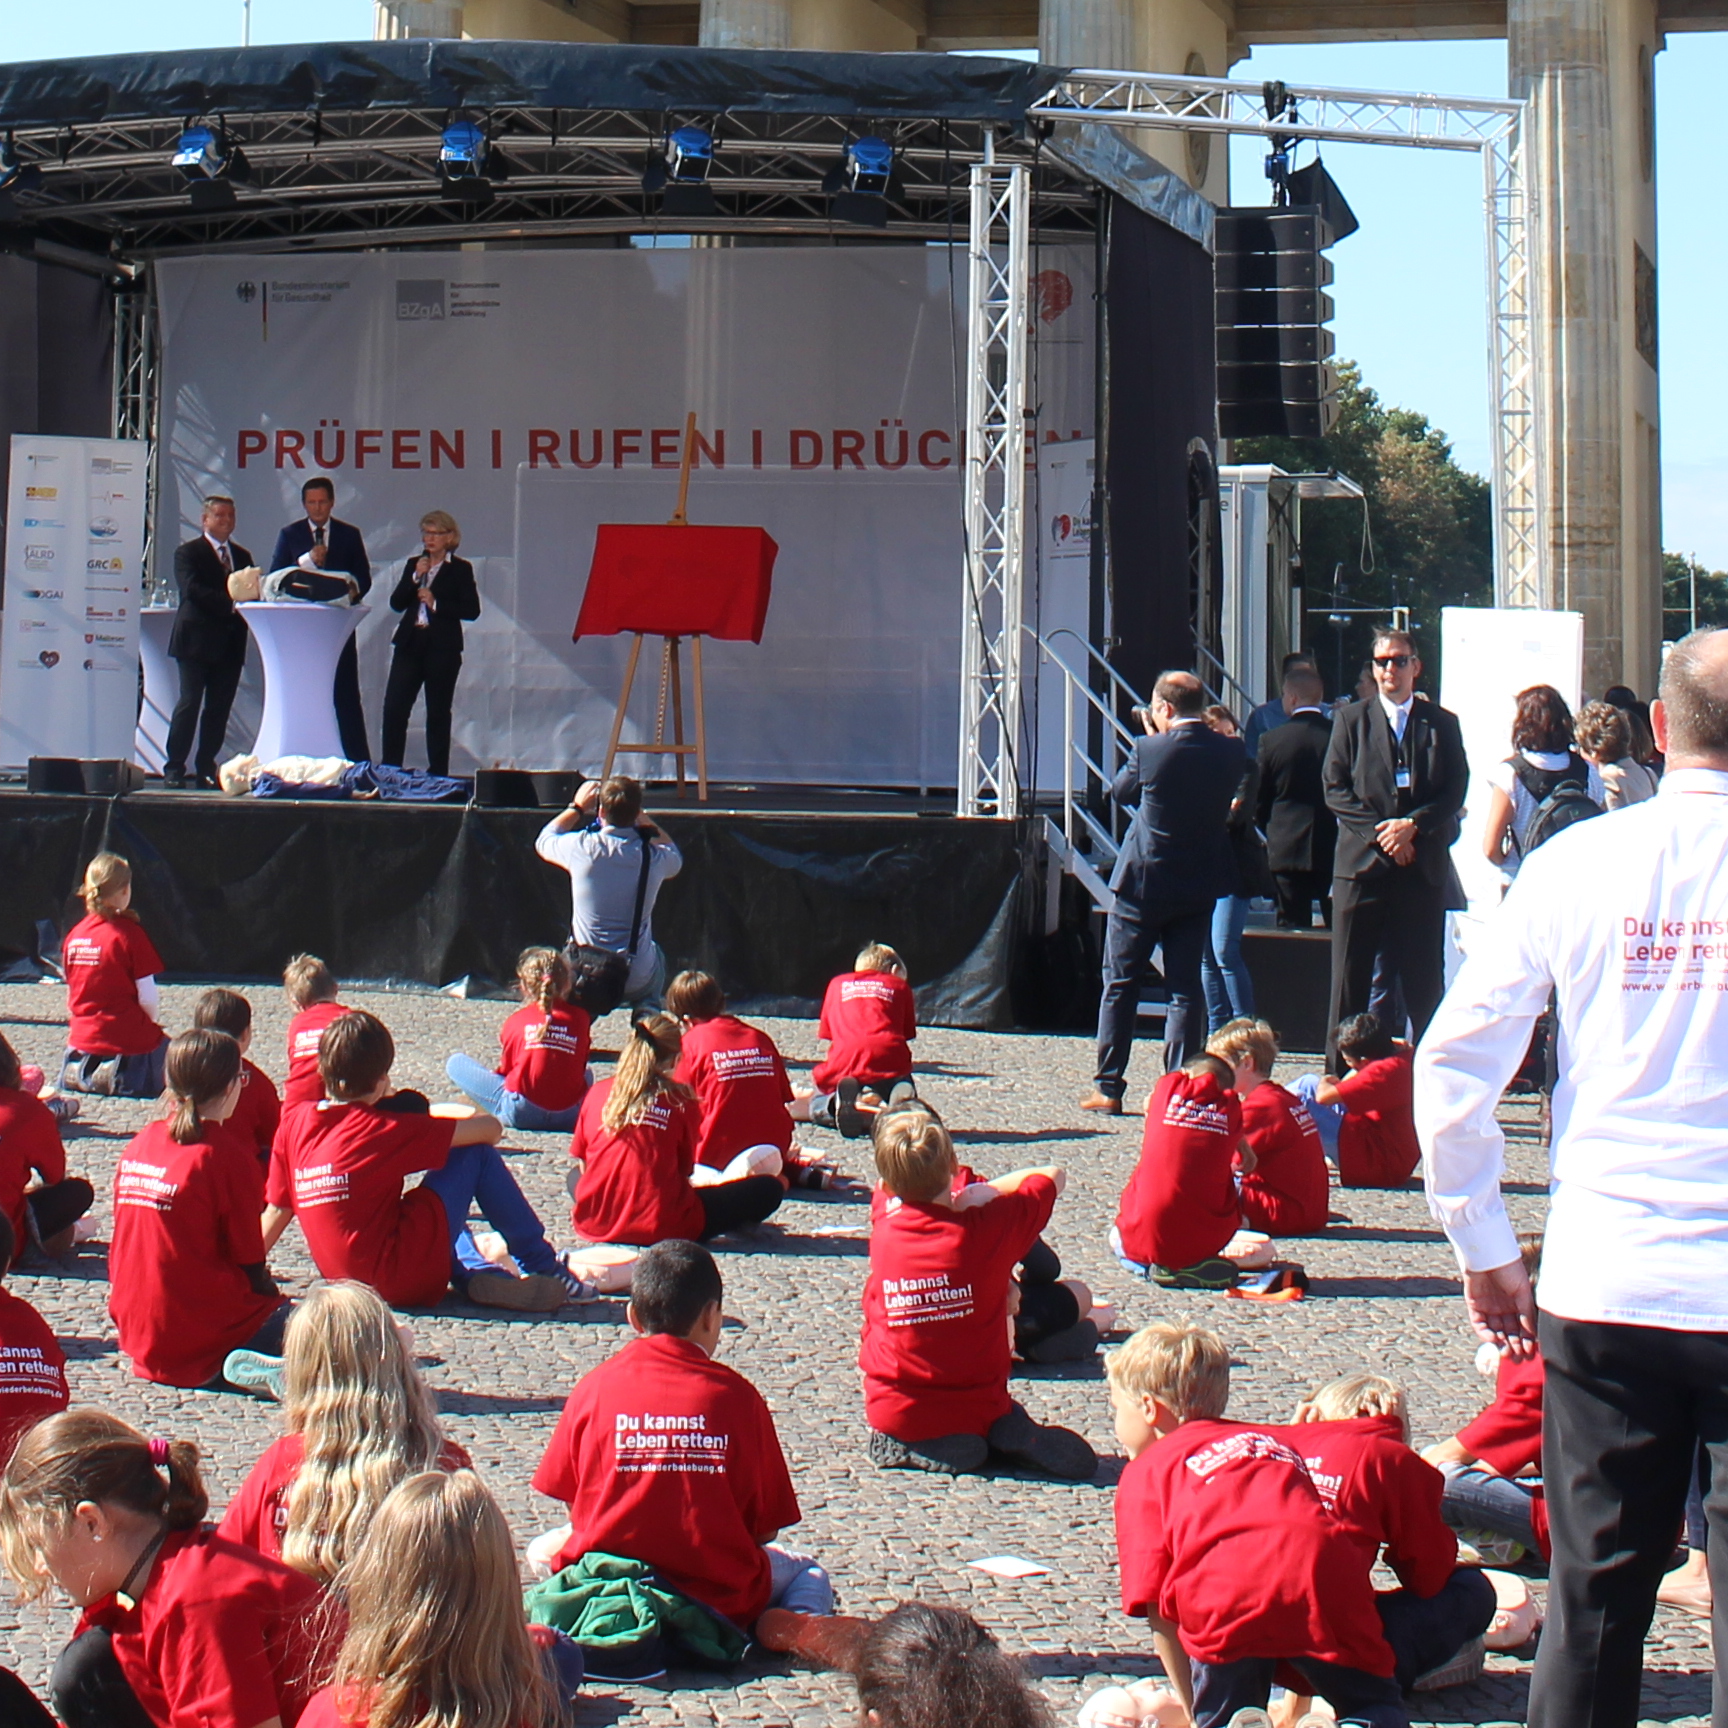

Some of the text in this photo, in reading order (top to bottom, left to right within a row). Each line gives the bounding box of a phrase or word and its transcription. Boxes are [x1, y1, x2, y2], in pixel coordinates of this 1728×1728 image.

[272, 281, 350, 291] Bundesministerium
[285, 292, 332, 302] Gesundheit
[399, 303, 442, 320] BZgA
[237, 419, 465, 469] PRÜFEN
[529, 429, 724, 470] RUFEN
[789, 419, 1082, 470] DRÜC
[87, 559, 110, 570] GRC
[1623, 916, 1653, 937] Du
[712, 1047, 761, 1061] Du kannst
[714, 1055, 773, 1071] Leben retten!
[132, 1161, 167, 1180] kannst
[140, 1177, 178, 1197] retten!
[312, 1172, 349, 1190] retten!
[882, 1273, 950, 1293] Du kannst
[884, 1284, 973, 1309] Leben retten!
[19, 1365, 61, 1380] retten!
[615, 1413, 706, 1431] Du kannst
[615, 1431, 729, 1451] Leben retten!
[1185, 1449, 1213, 1471] Du
